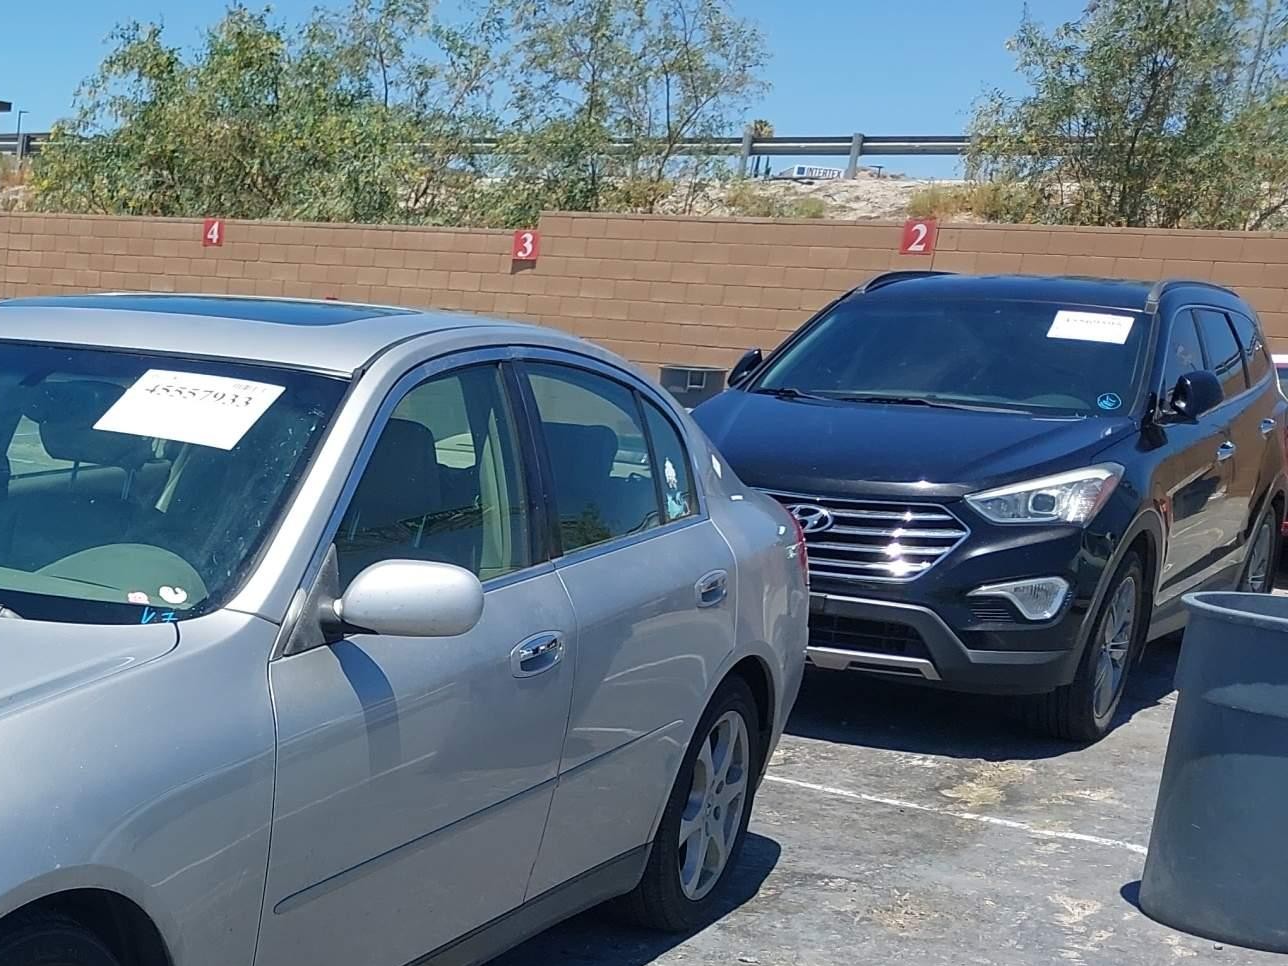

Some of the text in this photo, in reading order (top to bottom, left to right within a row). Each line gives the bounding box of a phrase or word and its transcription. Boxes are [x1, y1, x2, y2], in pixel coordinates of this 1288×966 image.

[207, 220, 219, 243] 4
[907, 223, 927, 251] 2
[517, 233, 533, 257] 3
